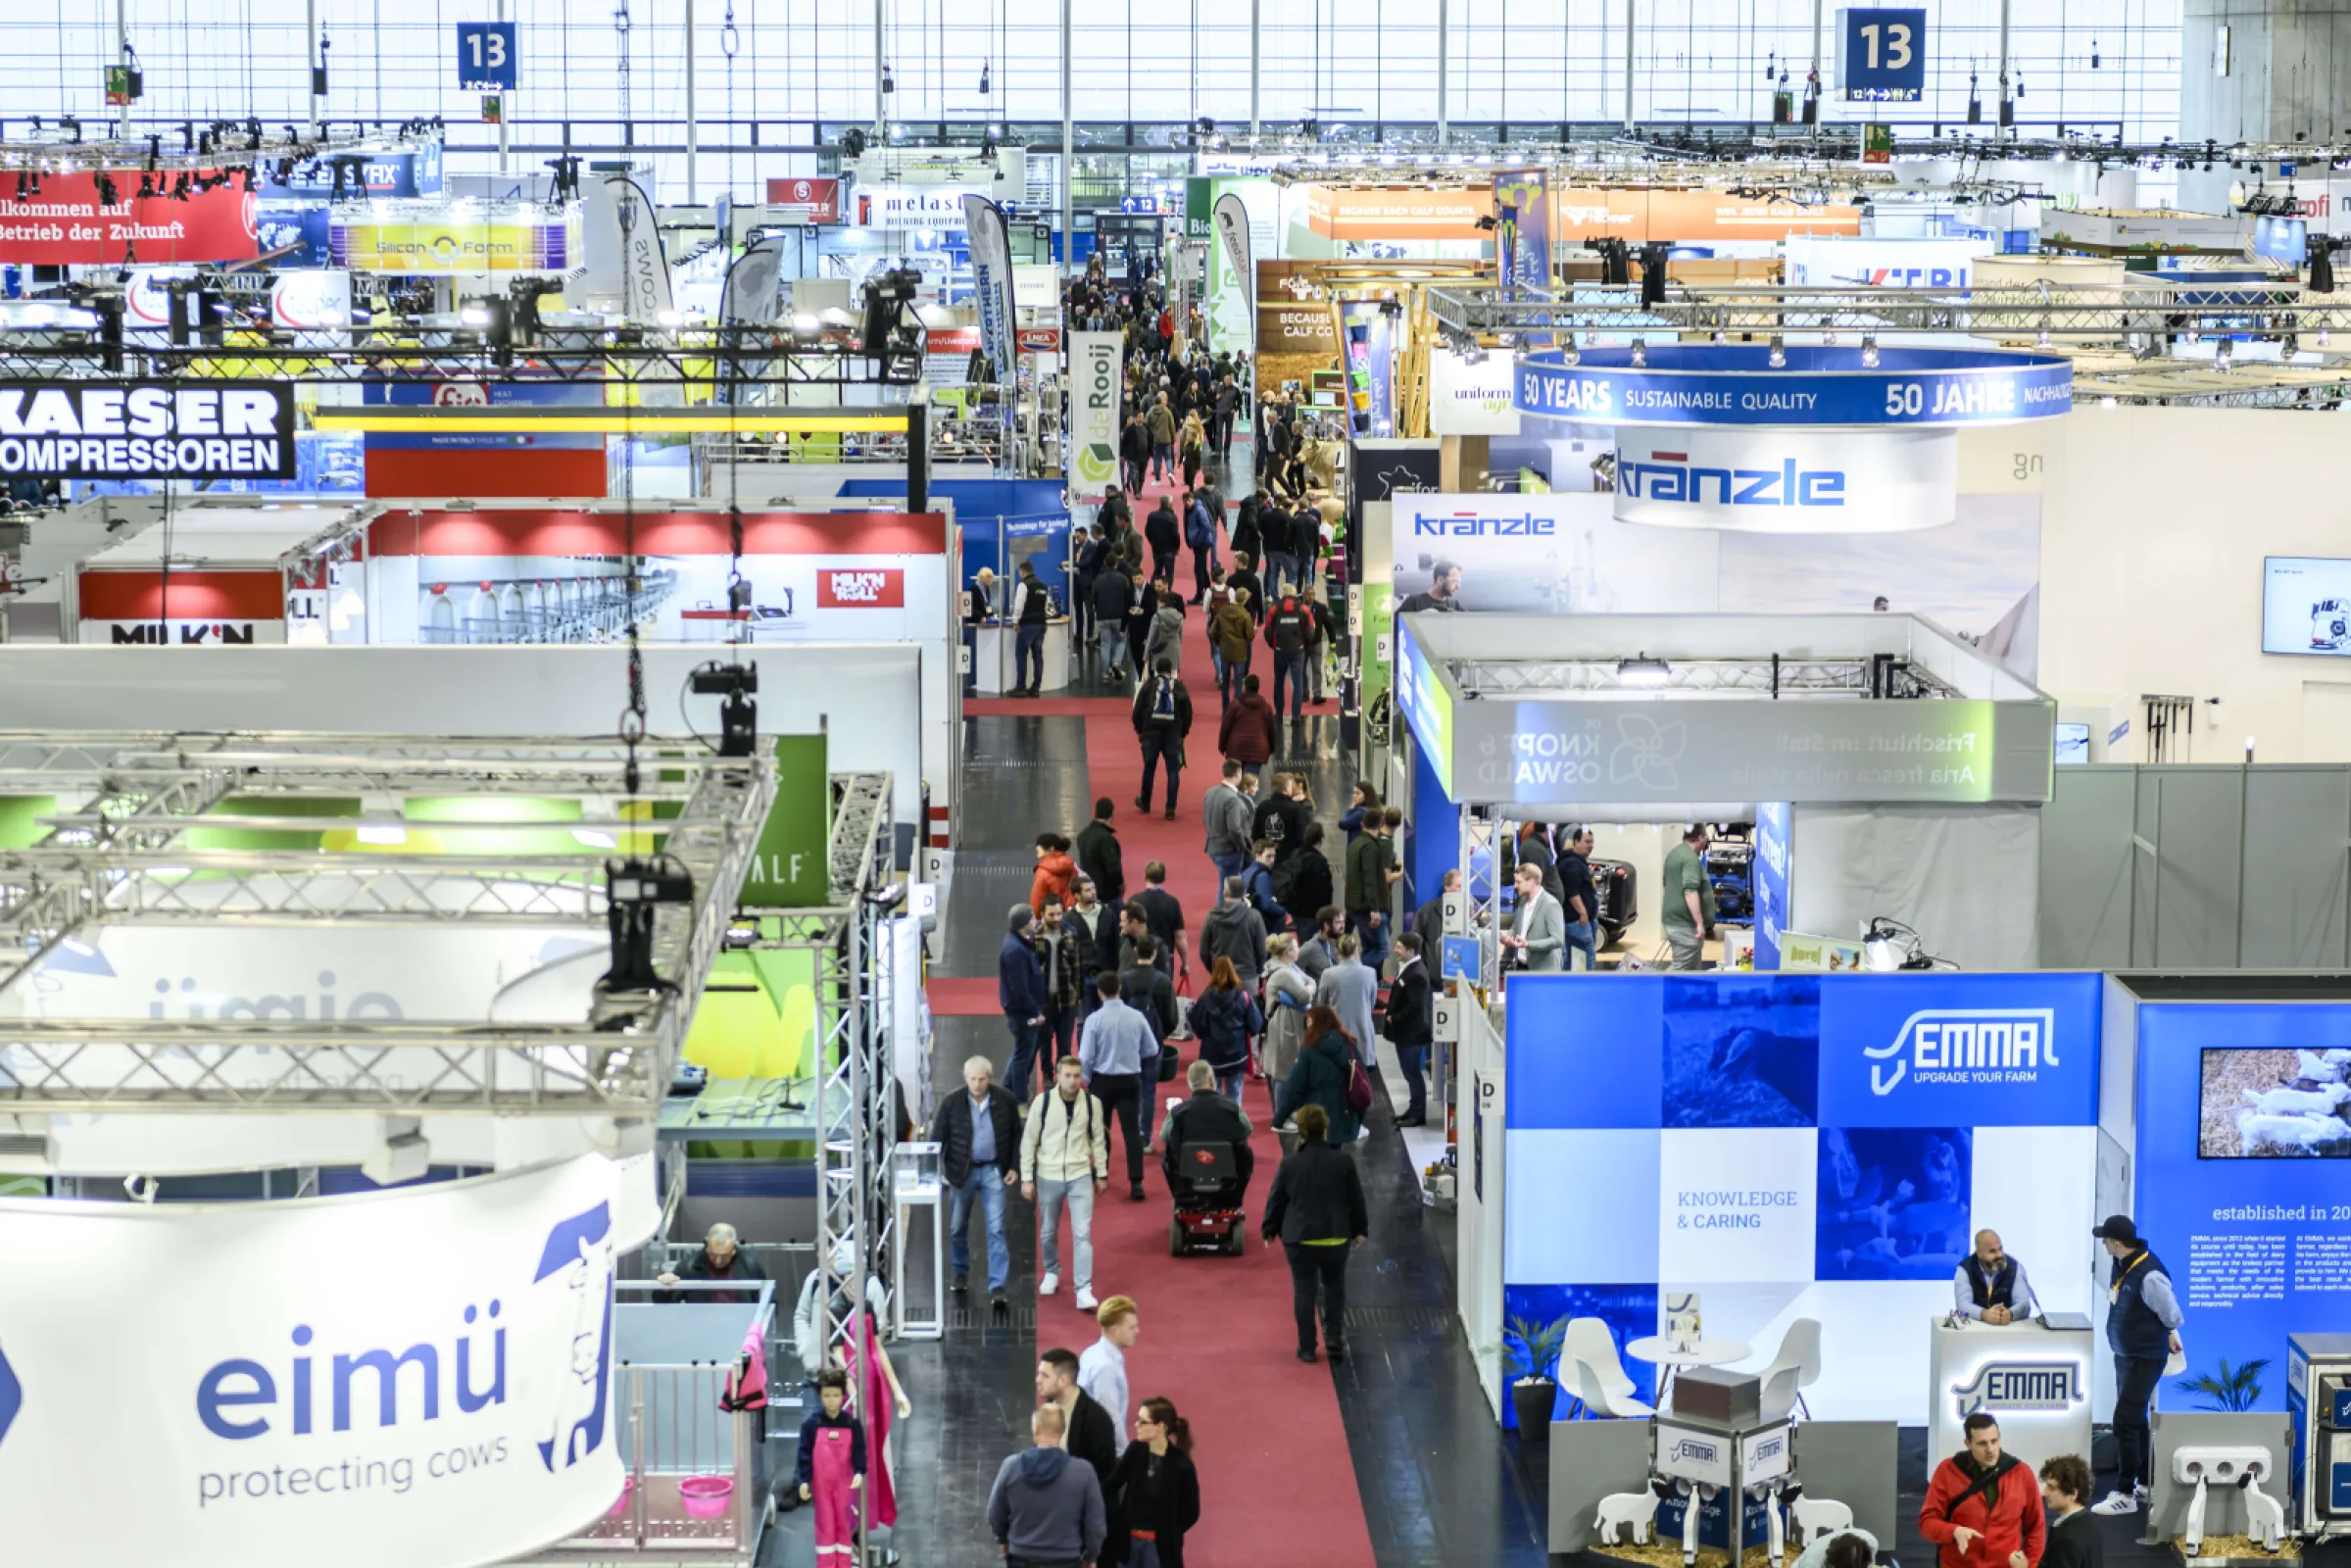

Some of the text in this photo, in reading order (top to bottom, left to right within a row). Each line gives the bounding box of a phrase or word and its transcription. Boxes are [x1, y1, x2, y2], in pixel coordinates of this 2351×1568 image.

[465, 33, 507, 68] 13
[1860, 24, 1912, 70] 13
[1, 199, 133, 217] lkommen auf
[1141, 199, 1152, 211] 12
[1339, 206, 1381, 216] BECAUSE
[1383, 206, 1408, 216] EACH
[1410, 206, 1434, 216] CALF
[2283, 194, 2330, 219] rofi
[69, 223, 102, 240] der
[110, 220, 185, 240] Zukunft
[1280, 313, 1331, 323] BECAUSE
[1284, 326, 1313, 337] CALF
[1454, 386, 1511, 400] uniform
[1524, 373, 1542, 408] 50
[1543, 378, 1612, 411] YEARS
[1625, 390, 1733, 411] SUSTAINABLE
[1740, 392, 1817, 412] QUALITY
[1886, 383, 1923, 416] 50
[1932, 380, 2016, 415] JAHRE
[0, 388, 280, 436] KAESER
[1, 438, 280, 472] OMPRESSOREN
[1616, 448, 1845, 508] kränzle
[1006, 519, 1047, 531] Technology for
[1414, 511, 1555, 537] kränzle
[1349, 616, 1357, 625] D
[1378, 642, 1386, 651] D
[752, 855, 803, 884] ALF
[931, 858, 940, 870] D
[924, 897, 933, 906] D
[1445, 905, 1455, 916] D
[1437, 1011, 1447, 1025] D
[1914, 1023, 2037, 1067] EMMA
[1914, 1072, 2037, 1084] UPGRADE YOUR FARM
[1483, 1083, 1494, 1097] D
[1677, 1191, 1798, 1207] KNOWLEDGE
[2212, 1204, 2351, 1221] established in 20
[1677, 1214, 1762, 1229] & CARING
[195, 1298, 507, 1441] eimü
[1987, 1372, 2067, 1399] EMMA
[1682, 1443, 1713, 1462] EMMA
[1757, 1441, 1780, 1461] EMMA
[199, 1434, 509, 1509] protecting cows
[1674, 1511, 1681, 1522] &
[1750, 1520, 1756, 1530] &
